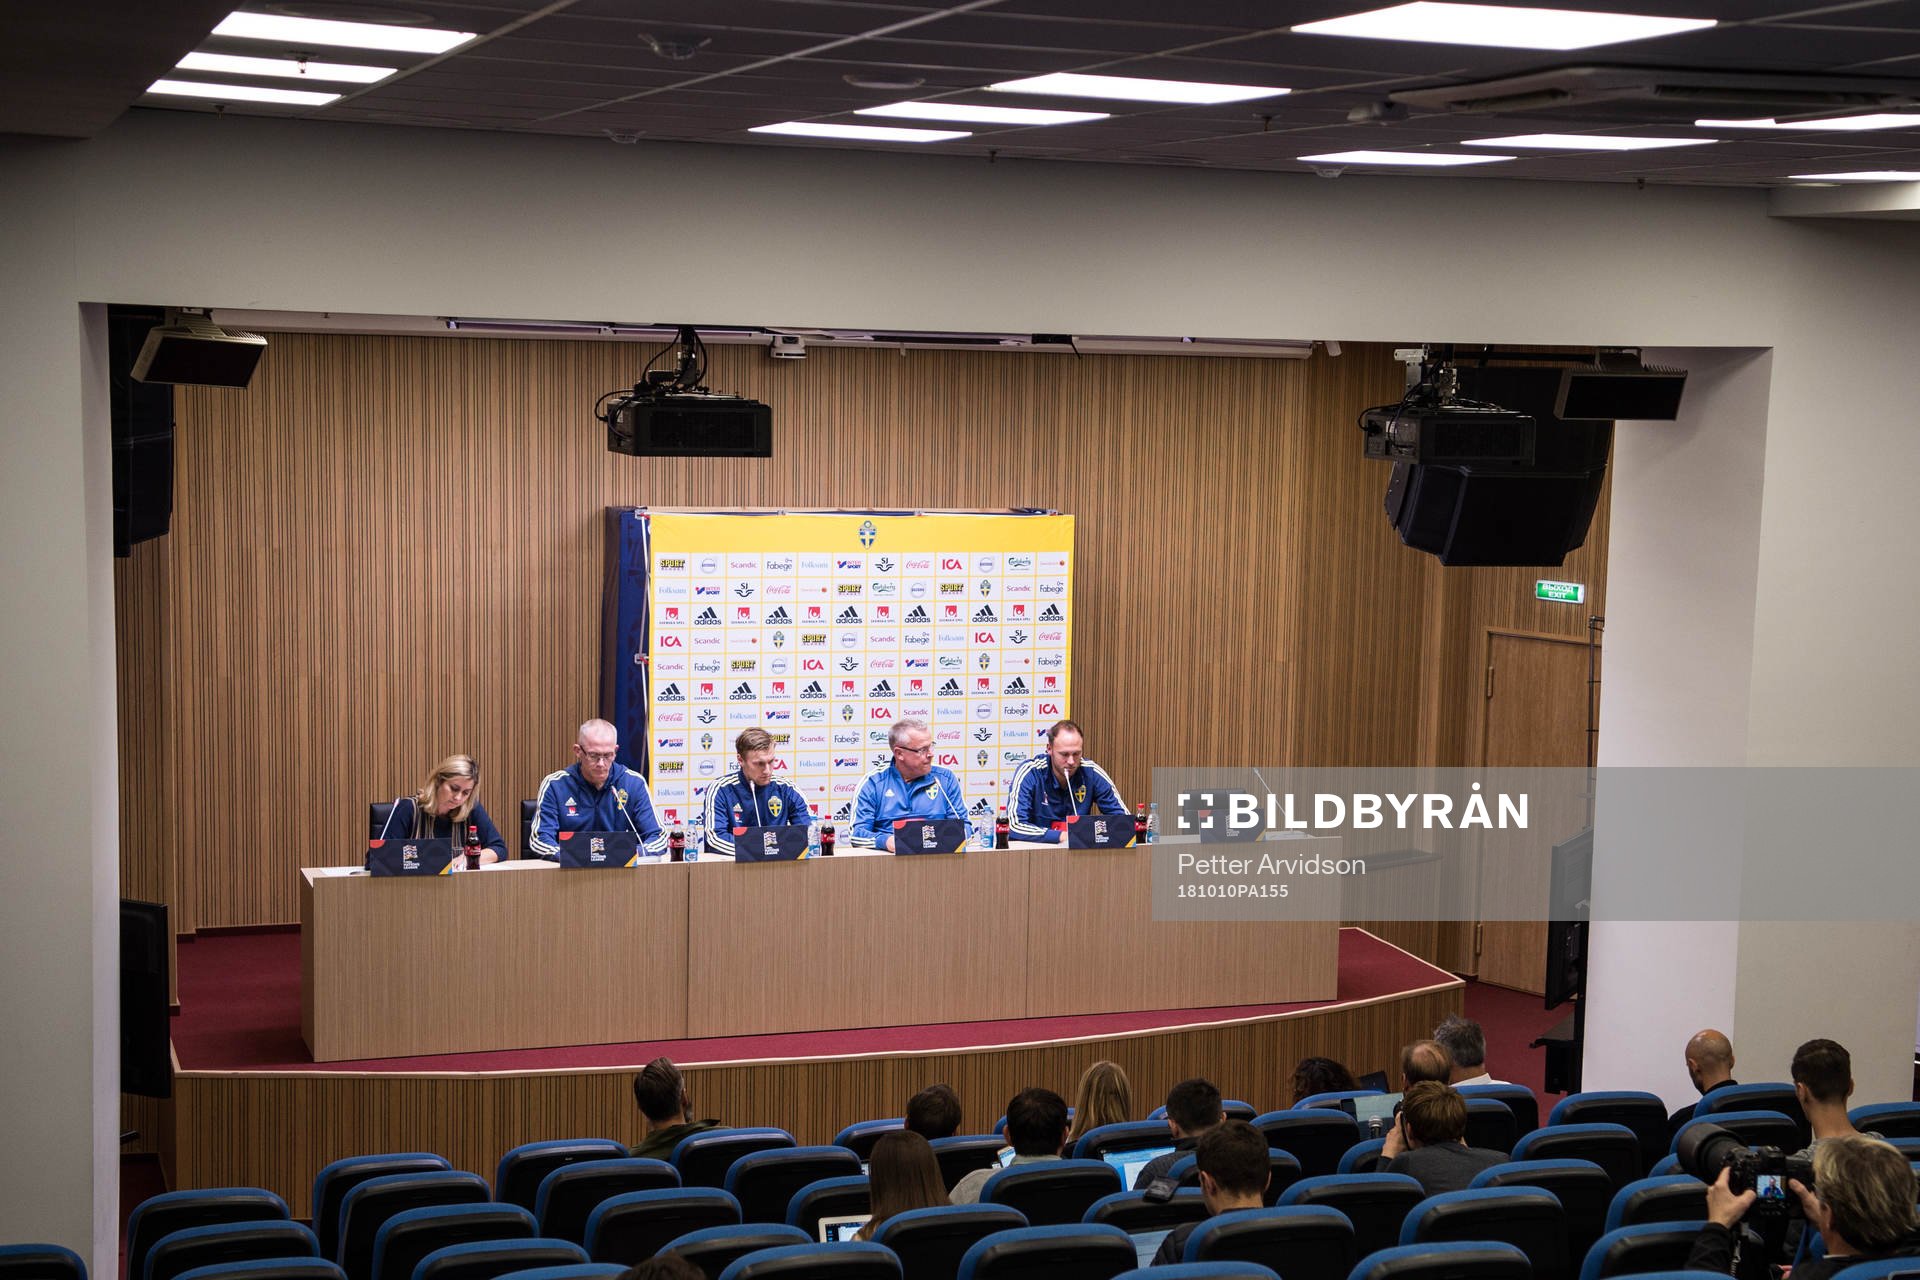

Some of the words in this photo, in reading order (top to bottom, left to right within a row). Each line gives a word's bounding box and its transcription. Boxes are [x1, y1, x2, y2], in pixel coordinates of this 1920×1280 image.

[660, 559, 685, 567] SPORT
[767, 561, 792, 571] Fabege
[942, 559, 962, 569] ICA
[1040, 585, 1063, 594] Fabege
[972, 615, 998, 623] adidas
[661, 636, 682, 647] ICA
[905, 635, 929, 645] Fabege
[975, 633, 994, 643] ICA
[731, 660, 755, 668] SPORT
[803, 660, 824, 670] ICA
[1038, 658, 1062, 666] Fabege
[694, 663, 720, 673] Fabege
[872, 708, 891, 718] ICA
[1004, 707, 1028, 716] Fabege
[1039, 704, 1058, 714] ICA
[835, 735, 859, 744] Fabege
[773, 759, 787, 769] CA
[939, 755, 958, 765] ICA
[659, 762, 684, 770] SPORT
